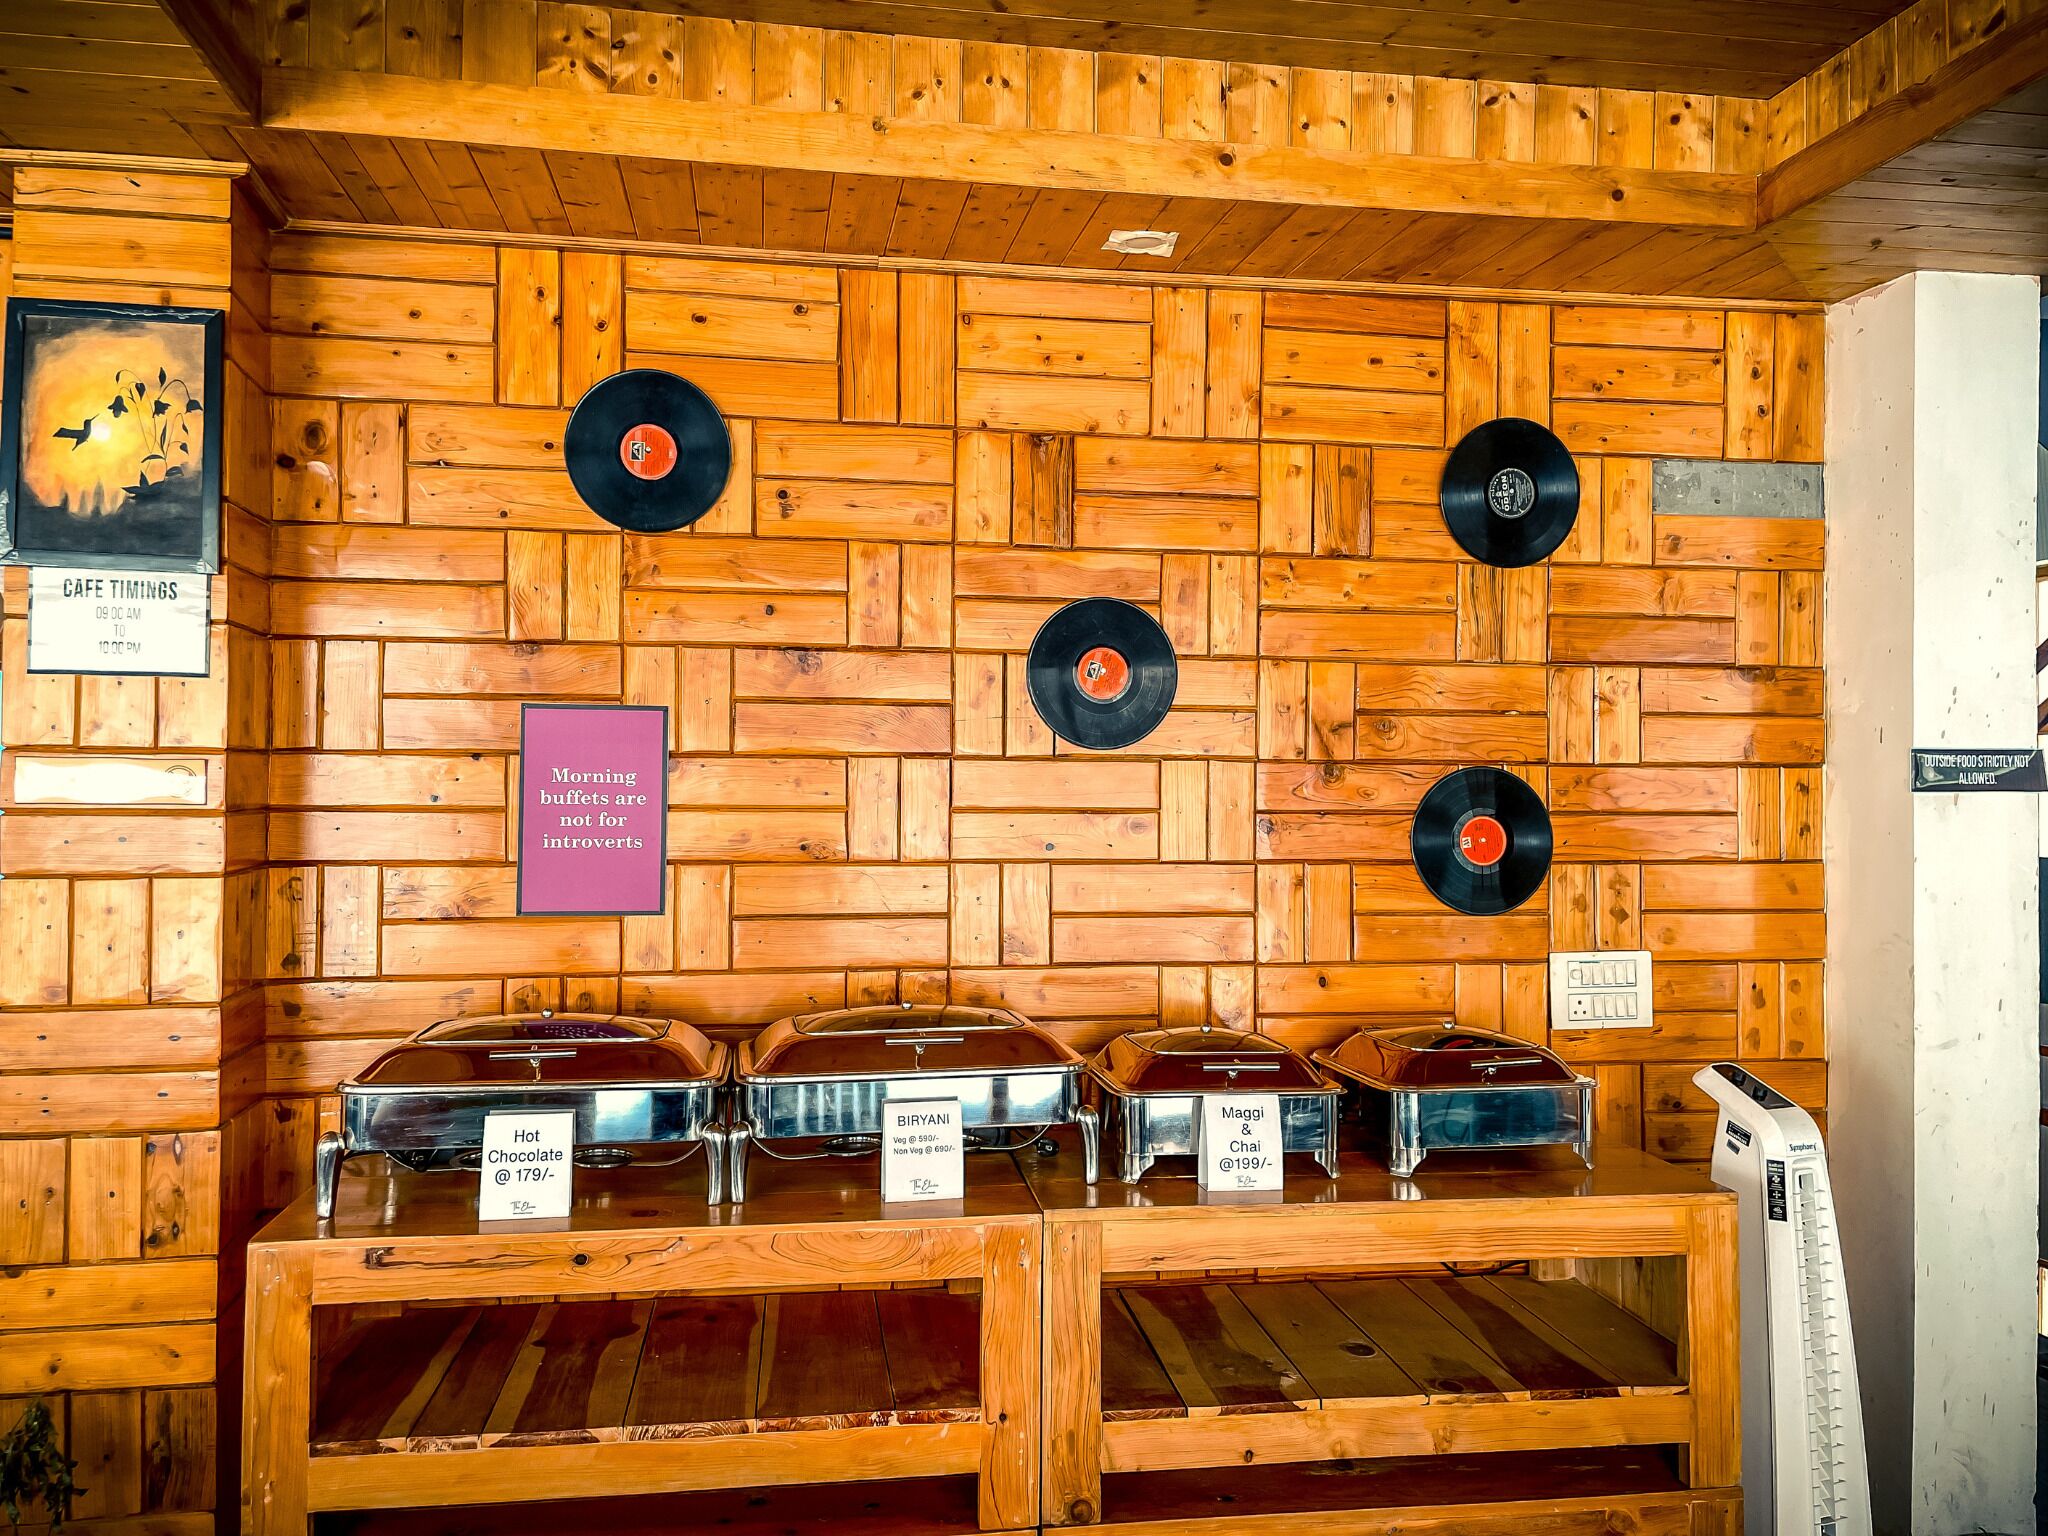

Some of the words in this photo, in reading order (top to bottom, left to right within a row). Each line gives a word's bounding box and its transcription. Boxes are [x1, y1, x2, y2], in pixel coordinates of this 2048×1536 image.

[63, 578, 104, 599] CAFE
[110, 579, 178, 600] TIMINGS
[126, 607, 141, 620] AM
[114, 624, 126, 637] TO
[126, 641, 141, 654] PM
[1924, 754, 1956, 768] OUTSIDE
[1957, 755, 1978, 768] FOOD
[1978, 755, 2013, 768] STRICTLY
[2014, 755, 2030, 768] NOT
[551, 768, 637, 786] Morning
[1958, 772, 1998, 785] ALLOWED.
[539, 789, 609, 806] buffets
[615, 793, 648, 806] are
[559, 813, 592, 828] not
[599, 811, 628, 827] for
[542, 834, 644, 850] introverts
[897, 1113, 950, 1127] BIRYANI
[1221, 1106, 1264, 1121] Maggi
[514, 1129, 541, 1143] Hot
[1241, 1123, 1252, 1136] &
[893, 1136, 907, 1145] Veg
[908, 1135, 917, 1145] @
[1229, 1140, 1261, 1153] Chai
[488, 1148, 563, 1163] Chocolate
[893, 1147, 908, 1156] Non
[909, 1146, 923, 1156] Veg
[924, 1145, 933, 1155] @
[1220, 1156, 1272, 1172] @199/-
[495, 1168, 511, 1186] @
[515, 1167, 555, 1182] 179/-
